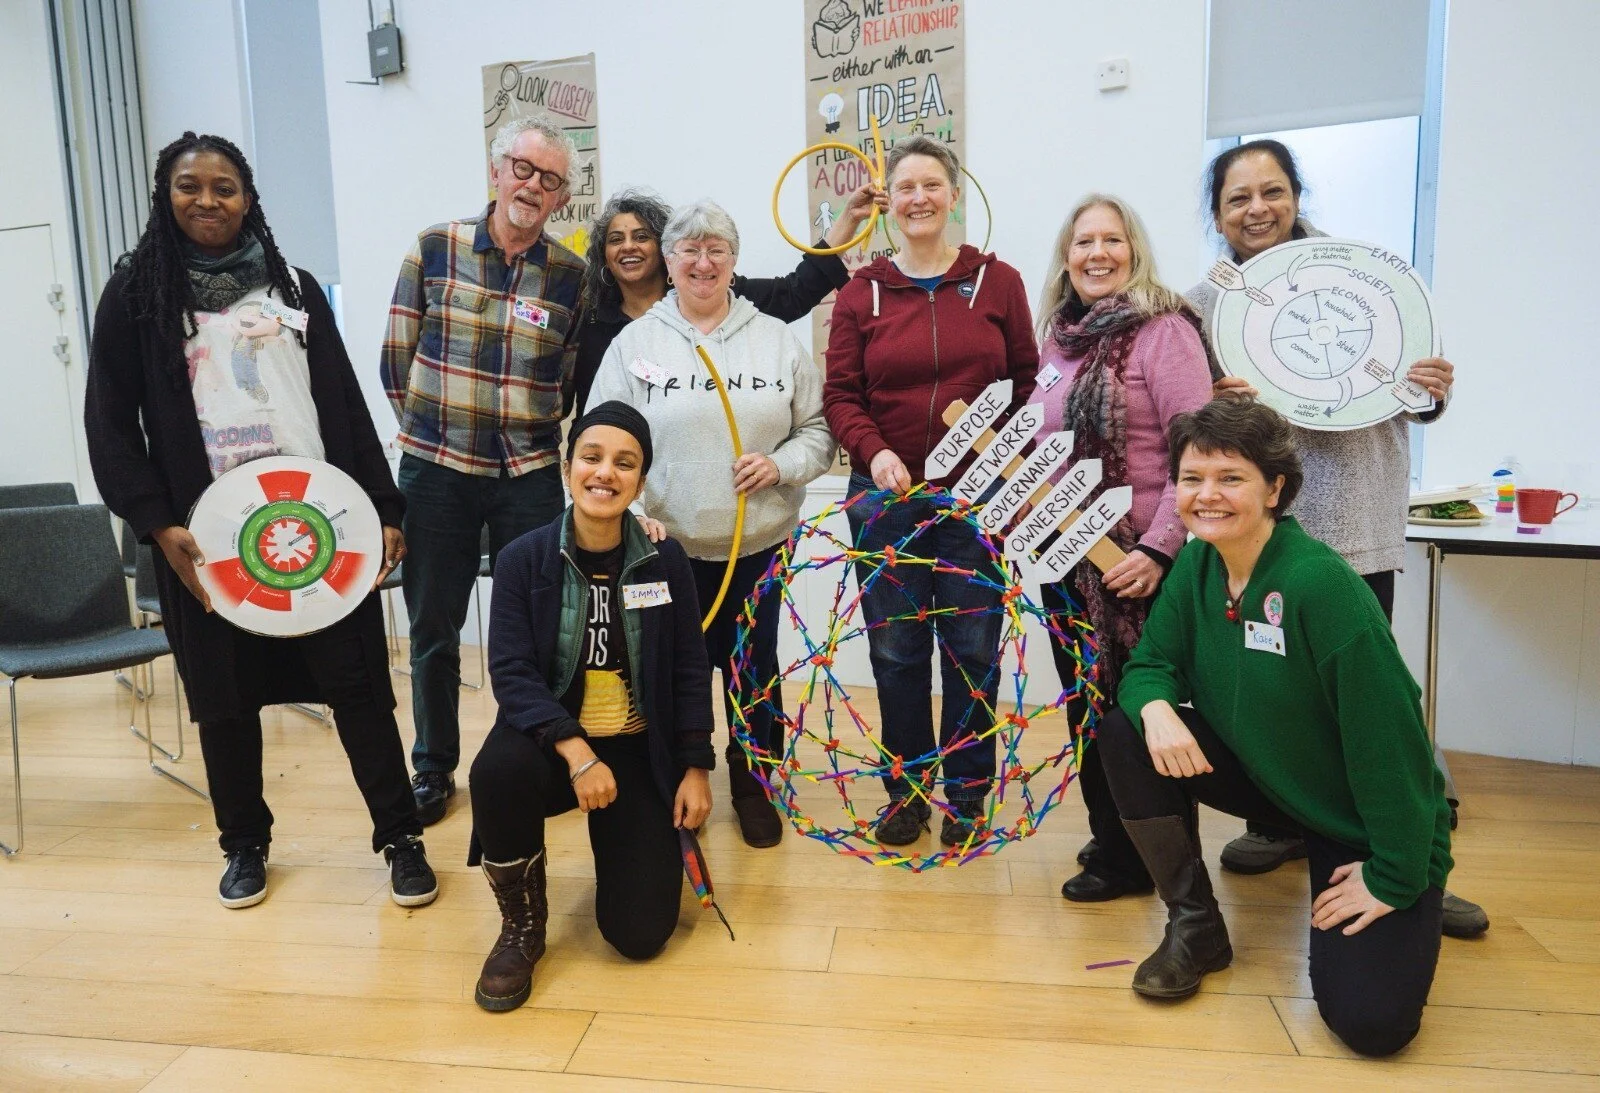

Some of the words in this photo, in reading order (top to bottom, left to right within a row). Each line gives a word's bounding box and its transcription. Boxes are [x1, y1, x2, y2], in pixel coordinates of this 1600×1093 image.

[862, 0, 884, 18] WE
[832, 58, 881, 82] either
[884, 45, 913, 69] with
[915, 50, 933, 65] an
[516, 73, 549, 106] LOOK
[547, 80, 595, 118] CLOSELY
[815, 167, 830, 189] A
[578, 202, 596, 222] LIKE
[1370, 247, 1412, 276] EARTH
[1348, 268, 1395, 297] SOCIETY
[1324, 300, 1357, 323] household
[1331, 286, 1378, 320] ECONOMY
[1288, 309, 1313, 326] market
[1290, 342, 1320, 364] commons
[1336, 339, 1357, 357] state
[1405, 385, 1423, 399] heat
[933, 392, 1004, 468] PURPOSE
[958, 411, 1037, 500] NETWORKS
[983, 437, 1067, 530] GOVERNANCE
[1011, 469, 1089, 554] OWNERSHIP
[1046, 502, 1116, 573] FINANCE
[631, 589, 661, 599] IMMY
[1253, 630, 1273, 645] Kate
